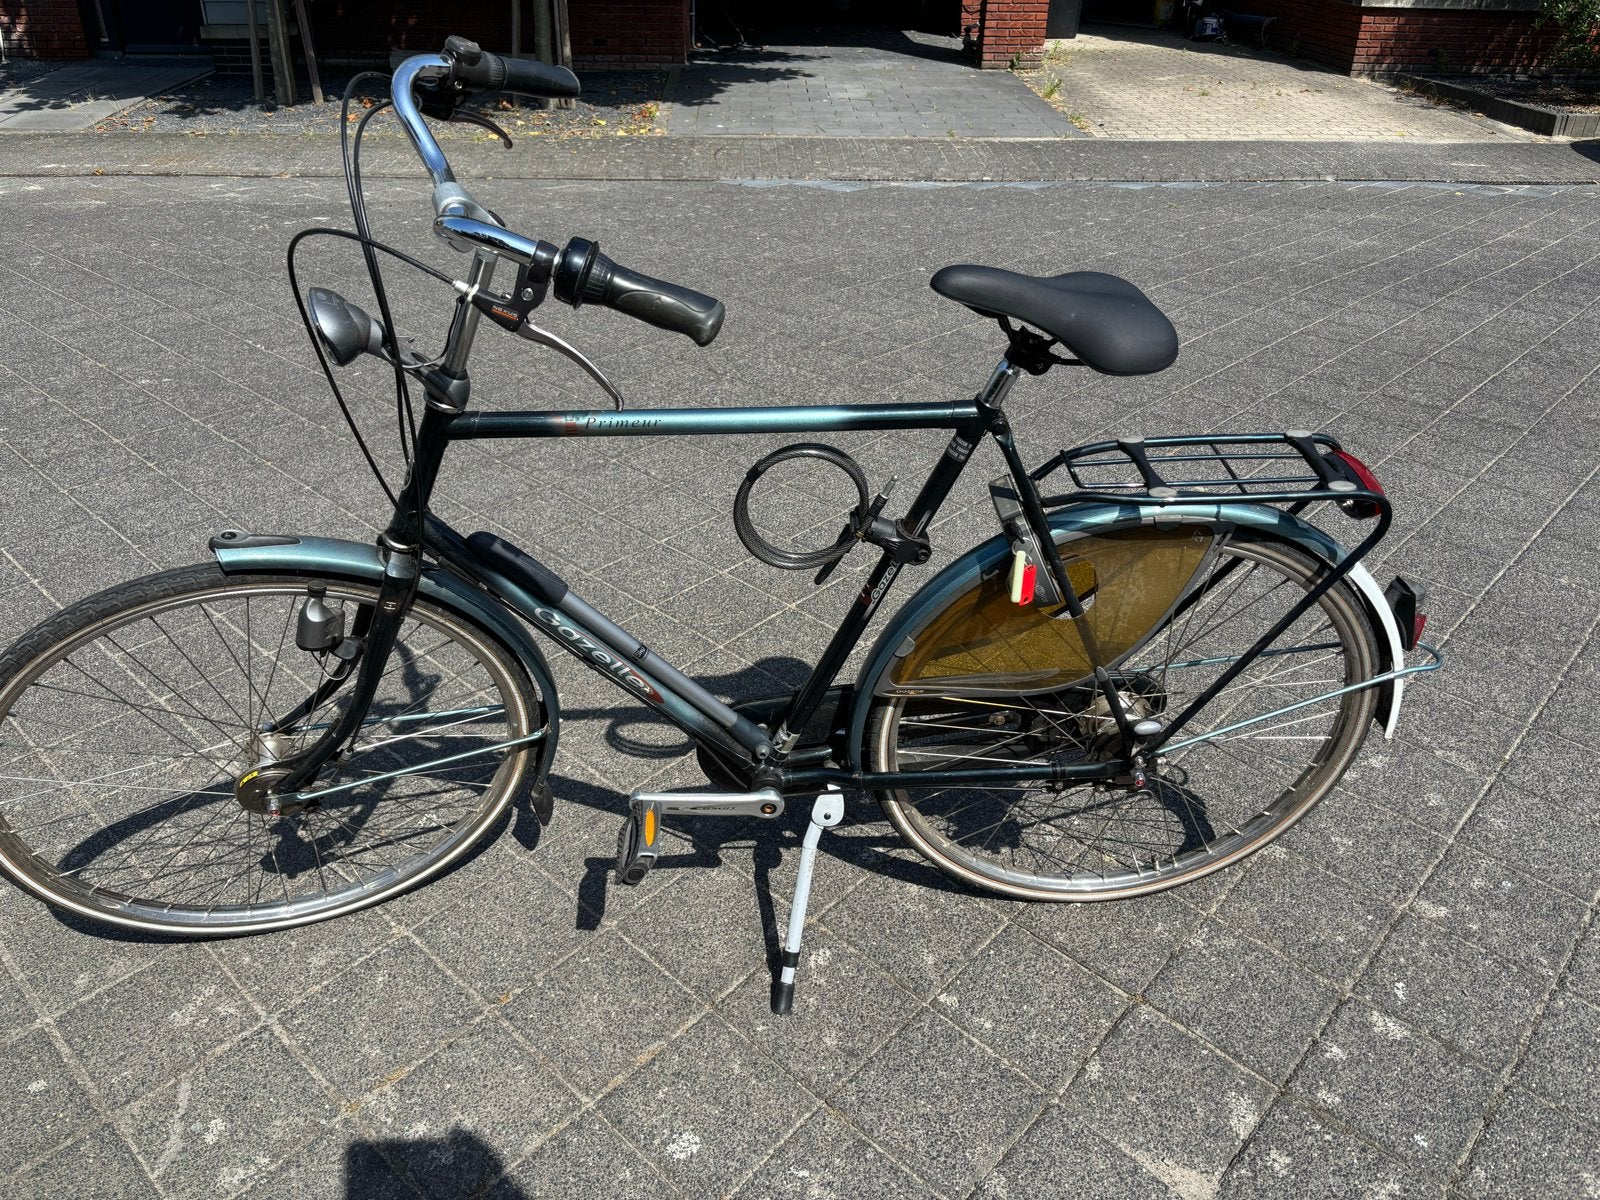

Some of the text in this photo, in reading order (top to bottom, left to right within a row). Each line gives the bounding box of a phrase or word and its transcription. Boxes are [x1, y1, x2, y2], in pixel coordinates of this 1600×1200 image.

[492, 305, 519, 318] NEXUS
[585, 416, 662, 429] Primeur
[534, 607, 648, 691] Gazelle
